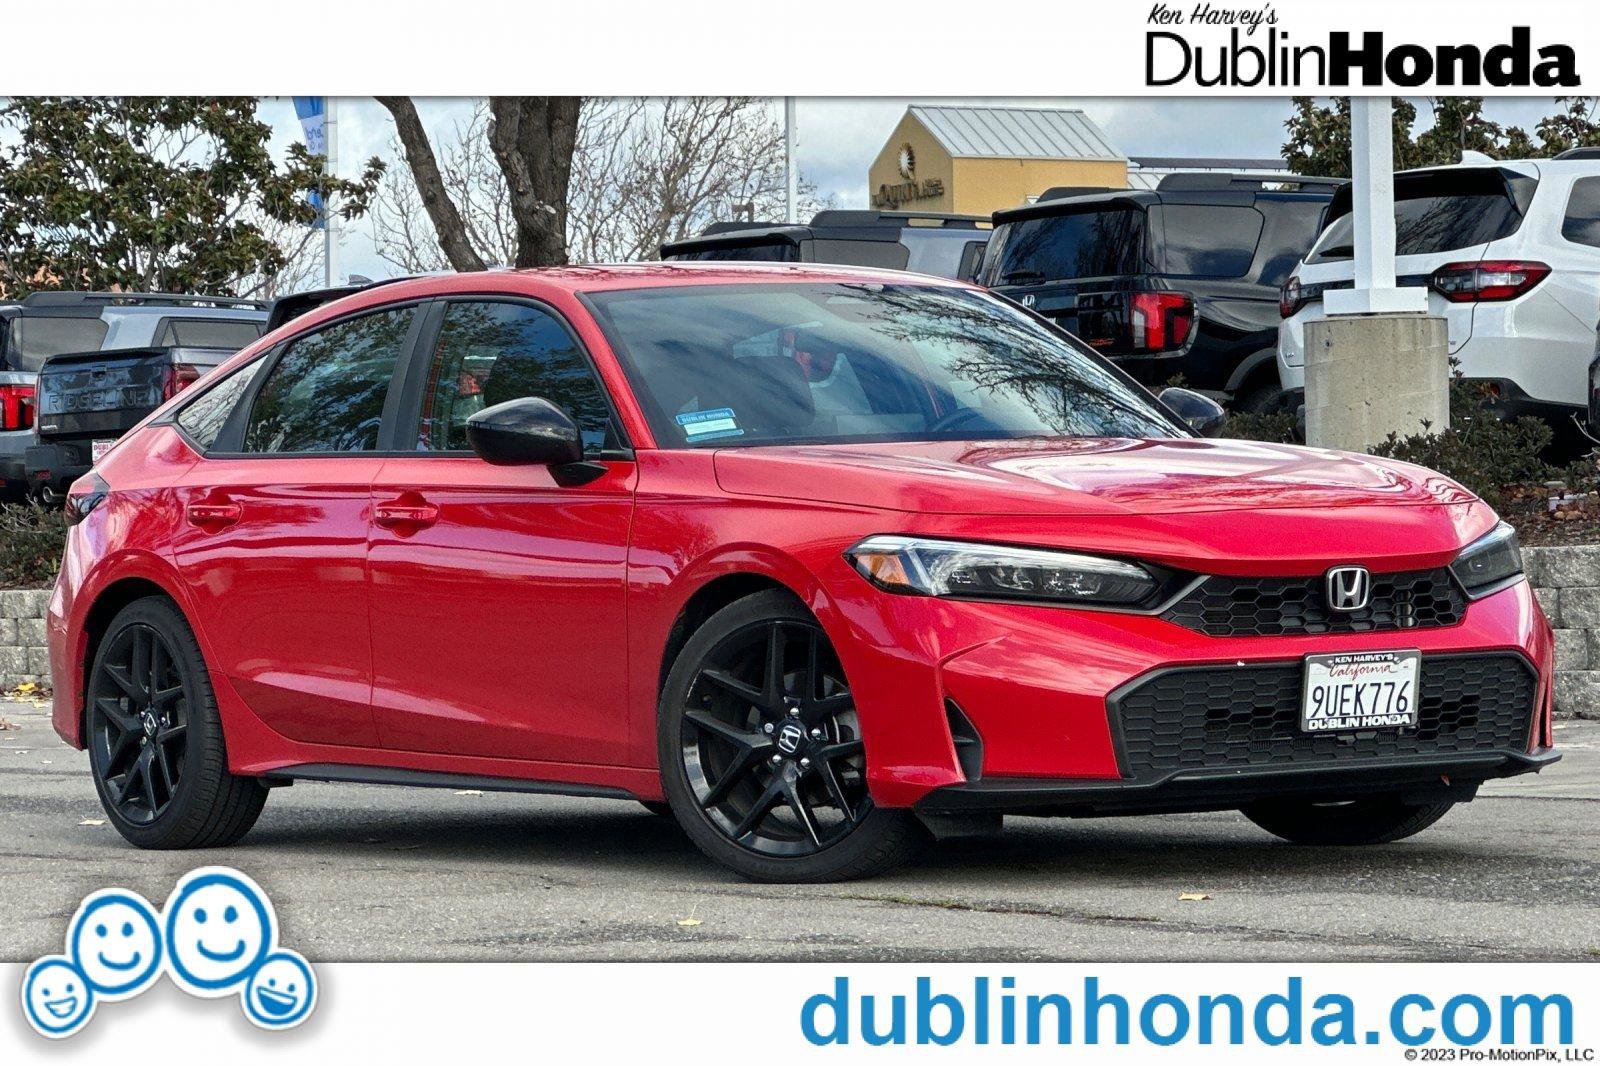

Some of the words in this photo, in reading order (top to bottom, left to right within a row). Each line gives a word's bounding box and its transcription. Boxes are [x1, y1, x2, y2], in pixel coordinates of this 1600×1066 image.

[1335, 656, 1352, 664] KEN
[1353, 654, 1394, 663] HARVEY'S
[1330, 663, 1398, 681] California
[1310, 680, 1410, 718] 9UEK776
[1308, 717, 1360, 730] DUBLIN
[1361, 714, 1411, 728] HONDA
